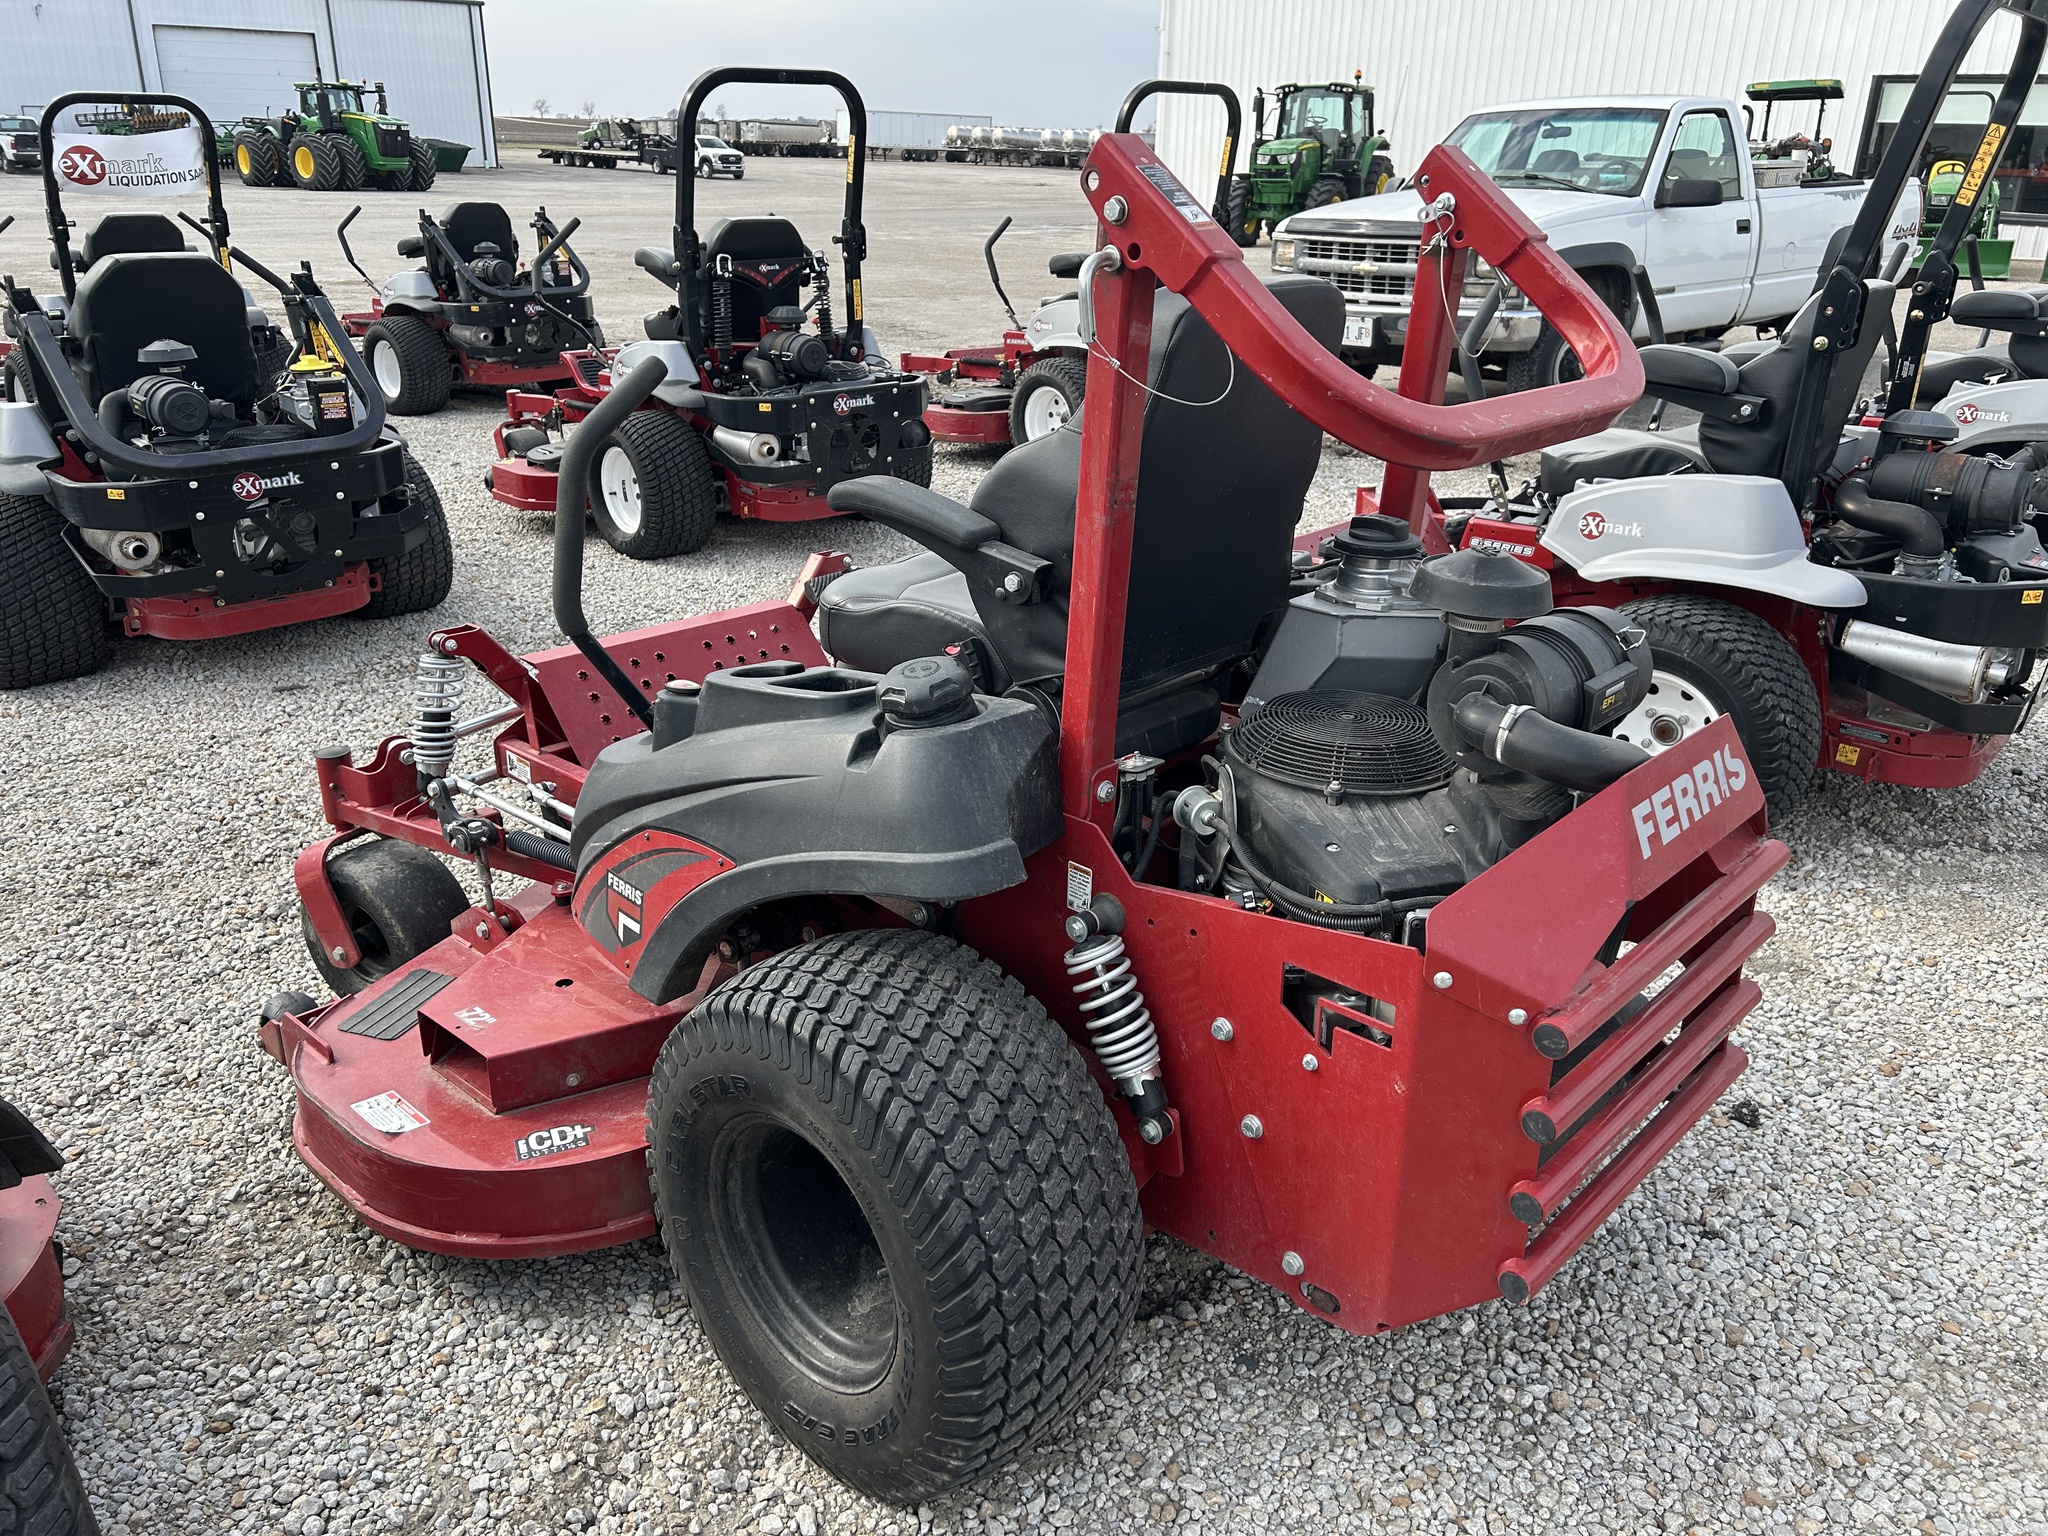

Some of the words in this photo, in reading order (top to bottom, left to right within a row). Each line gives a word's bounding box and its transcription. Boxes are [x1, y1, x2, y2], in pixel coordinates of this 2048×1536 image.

[58, 153, 166, 180] eXmark
[108, 170, 187, 188] LIQUIDATION
[1891, 222, 1918, 240] 4x4
[833, 394, 875, 412] eXmark
[1956, 406, 2010, 423] eXmark
[232, 471, 303, 497] eXmark
[1579, 514, 1643, 538] eXmark
[1631, 743, 1746, 860] FERRIS
[607, 871, 643, 906] FERRIS
[666, 1073, 753, 1175] CARLSTAR
[520, 1140, 587, 1159] CUTTING
